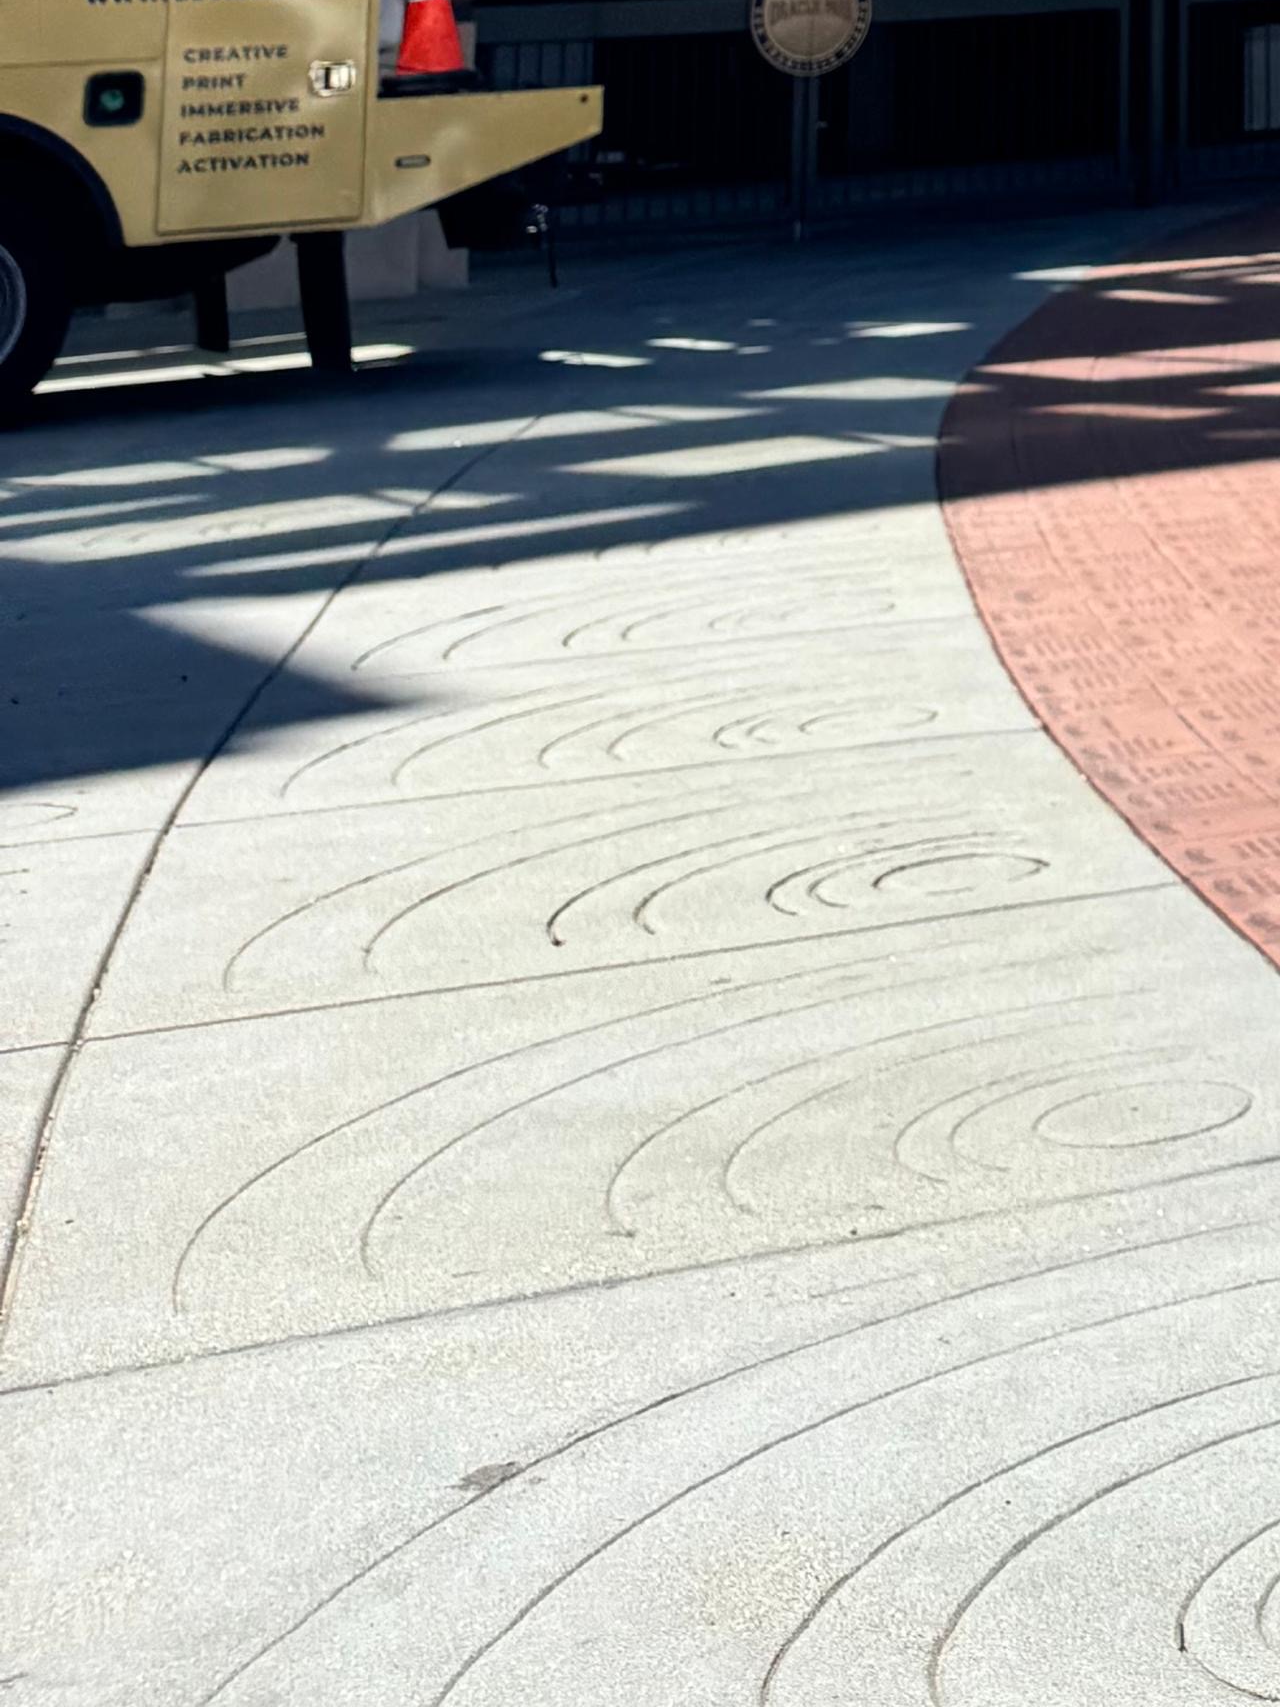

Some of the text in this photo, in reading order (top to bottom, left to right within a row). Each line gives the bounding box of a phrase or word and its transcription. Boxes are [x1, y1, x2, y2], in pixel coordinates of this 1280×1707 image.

[183, 44, 289, 64] CREATIVE
[181, 73, 247, 91] PRINT
[180, 97, 301, 119] IMMERSIVE
[178, 125, 326, 147] FABRICATION
[177, 153, 311, 175] ACTIVATION
